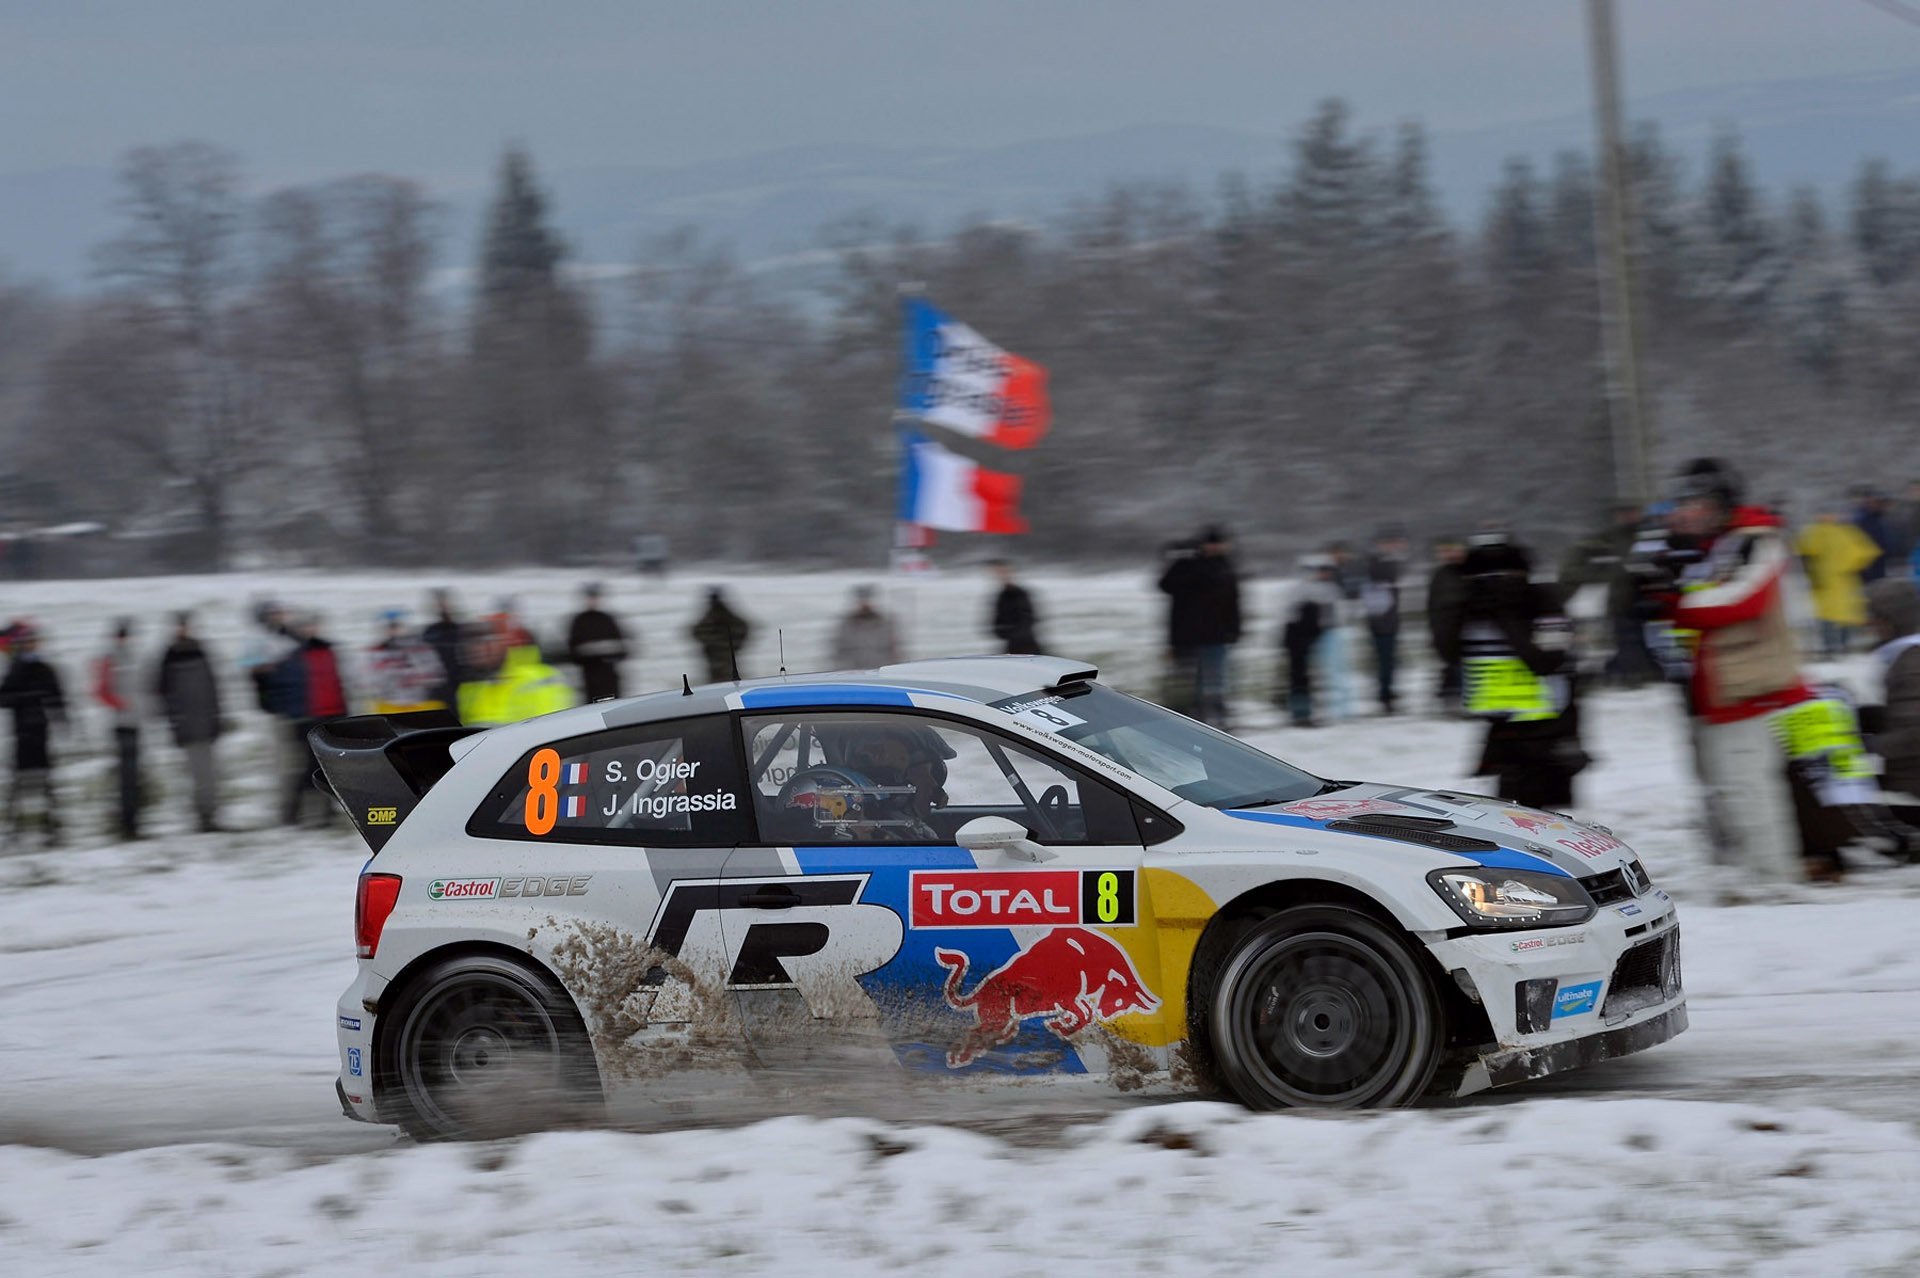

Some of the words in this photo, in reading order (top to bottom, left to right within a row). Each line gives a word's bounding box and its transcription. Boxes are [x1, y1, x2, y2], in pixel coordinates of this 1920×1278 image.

[1030, 709, 1070, 726] 8
[1012, 720, 1132, 780] www.volkswagen-motorsport.com
[605, 760, 628, 782] S.
[636, 758, 701, 792] Ogier
[525, 748, 561, 836] 8
[603, 794, 623, 816] J.
[632, 788, 737, 818] Ingrassia
[367, 810, 397, 823] OMP
[445, 880, 495, 897] Castrol
[499, 874, 593, 898] EDGE
[921, 883, 1070, 916] TOTAL
[1097, 872, 1119, 923] 8
[633, 871, 905, 1024] R
[1518, 938, 1544, 950] Castrol
[1547, 932, 1586, 947] EDGE
[1557, 988, 1593, 1003] ultimate
